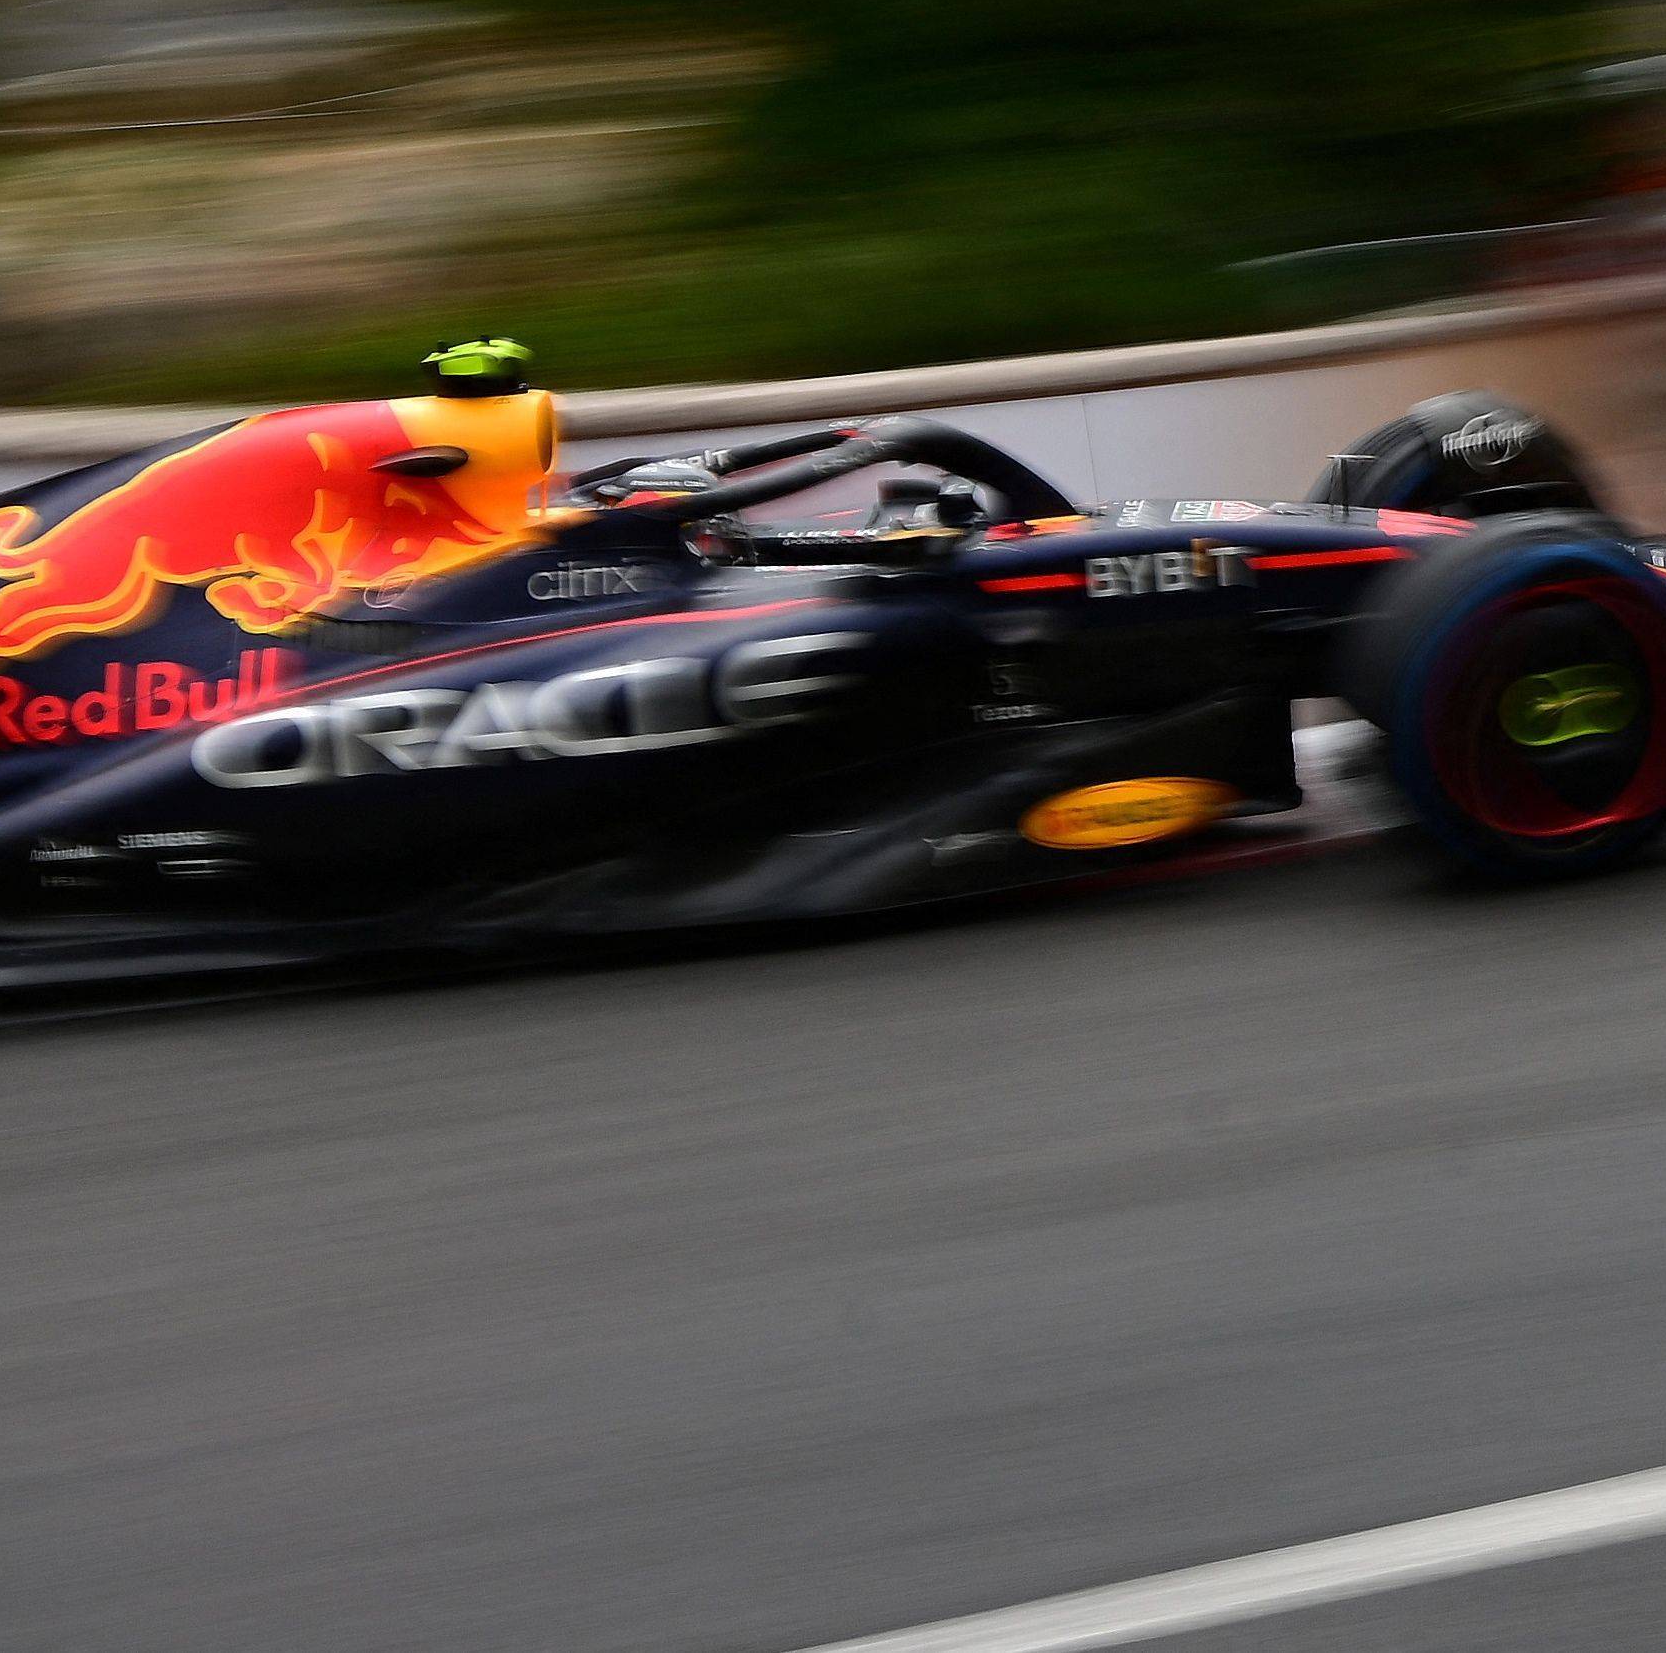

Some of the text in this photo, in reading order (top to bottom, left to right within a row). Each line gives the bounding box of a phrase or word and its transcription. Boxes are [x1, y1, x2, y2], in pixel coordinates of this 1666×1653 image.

[1085, 538, 1255, 598] BYBIT
[135, 647, 293, 731] Bull
[190, 631, 879, 789] ORACLE
